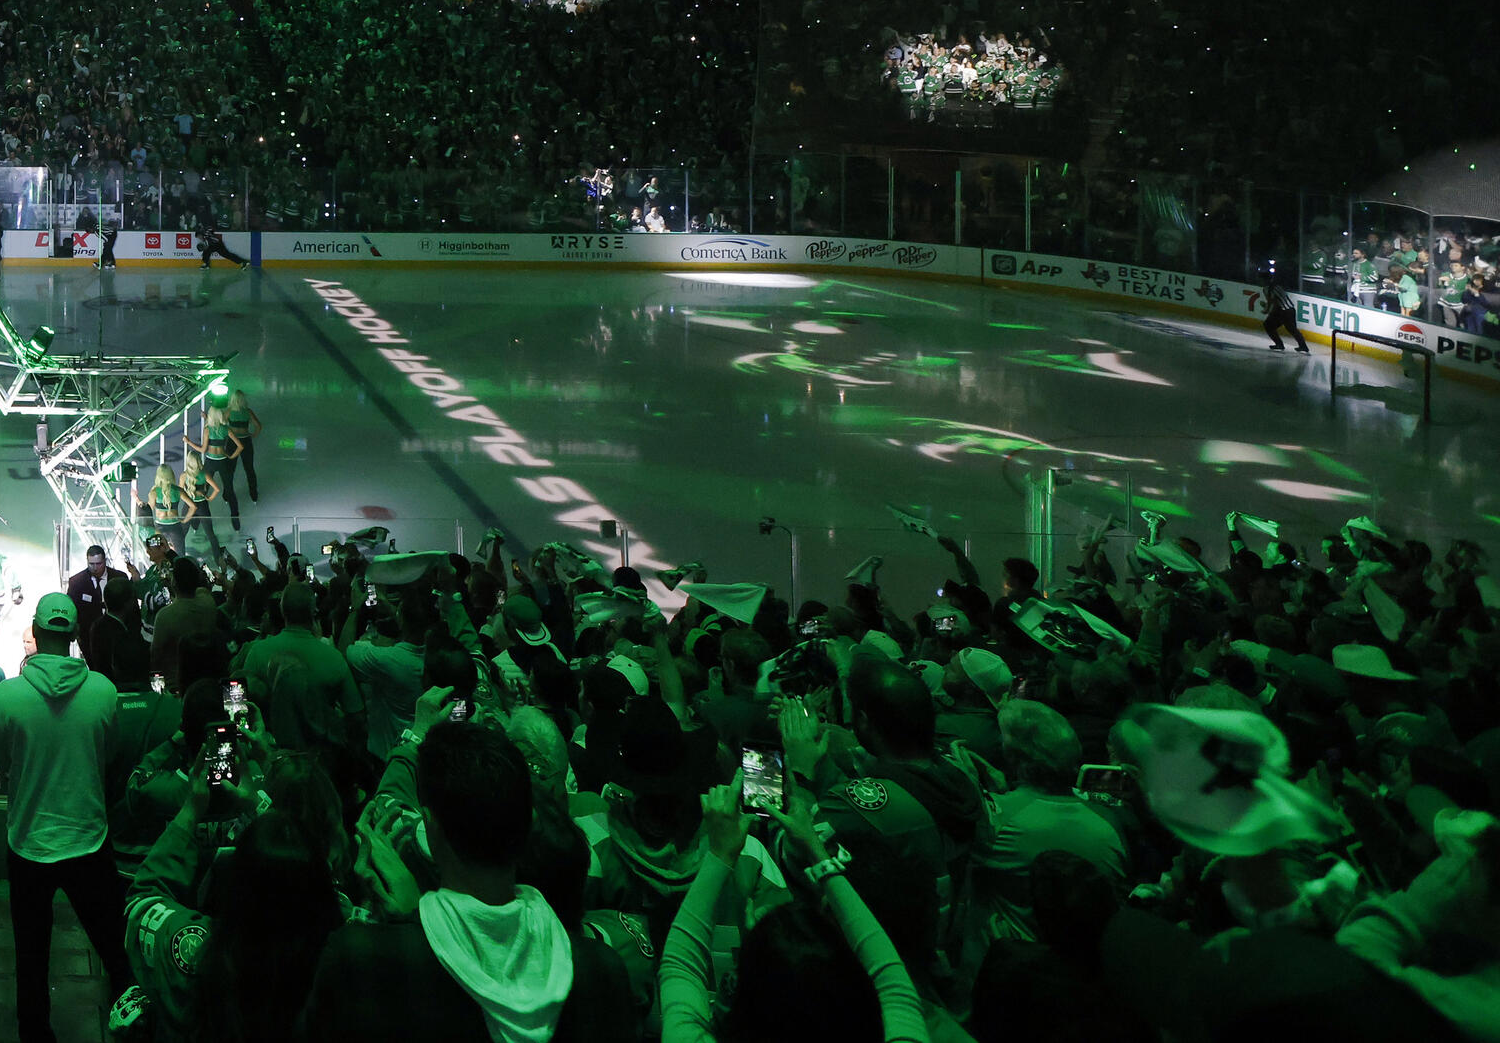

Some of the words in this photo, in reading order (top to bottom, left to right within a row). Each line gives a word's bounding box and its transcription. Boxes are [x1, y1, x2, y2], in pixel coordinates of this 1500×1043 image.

[292, 239, 360, 254] American
[438, 240, 510, 252] Higginbotham
[569, 235, 625, 249] RYSE
[751, 247, 788, 260] Bank
[808, 242, 844, 260] Pepper
[897, 246, 933, 264] Pepper
[1117, 266, 1161, 281] BEST
[1168, 274, 1186, 287] IN
[1117, 279, 1185, 301] TEXAS
[302, 278, 410, 344] HOCKEY
[1397, 331, 1424, 345] PEPSI
[122, 701, 147, 710] Reebok
